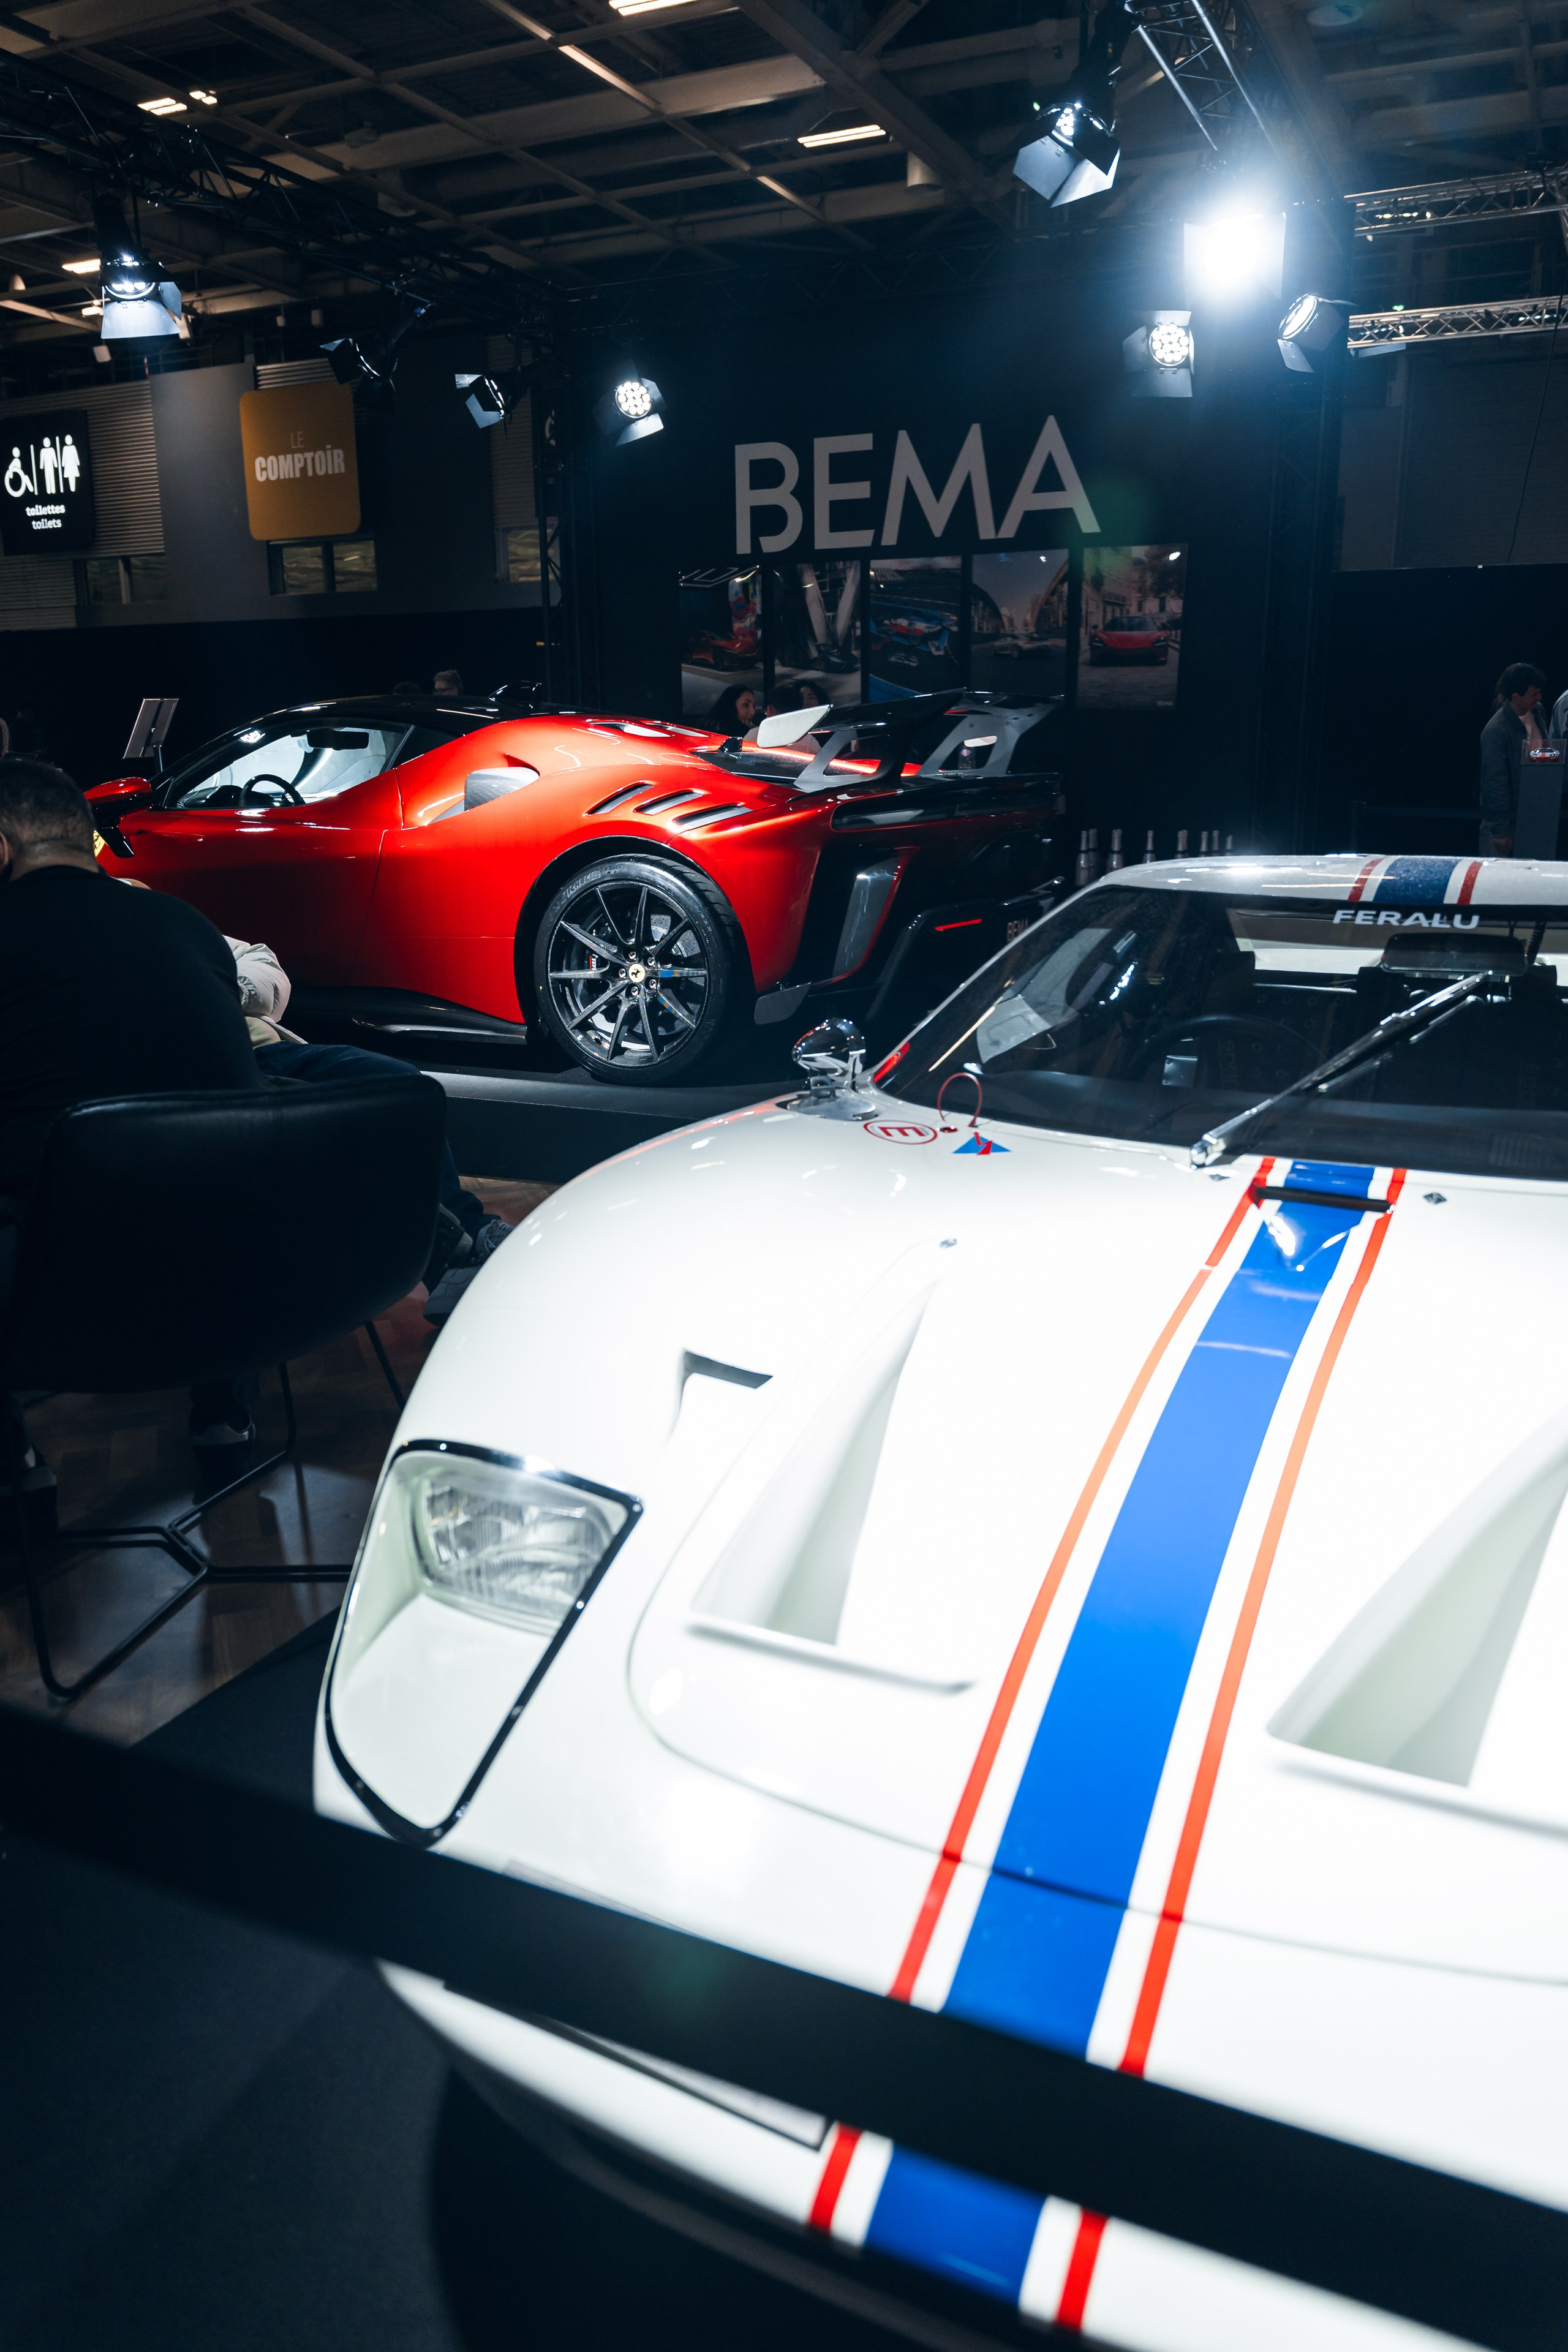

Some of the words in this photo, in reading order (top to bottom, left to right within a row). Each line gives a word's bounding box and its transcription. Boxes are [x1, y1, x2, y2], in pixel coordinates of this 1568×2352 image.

[290, 431, 304, 448] LE
[734, 415, 1101, 555] BEMA
[25, 504, 66, 516] toilettes
[31, 518, 62, 530] toilets
[1332, 909, 1480, 930] FERALU
